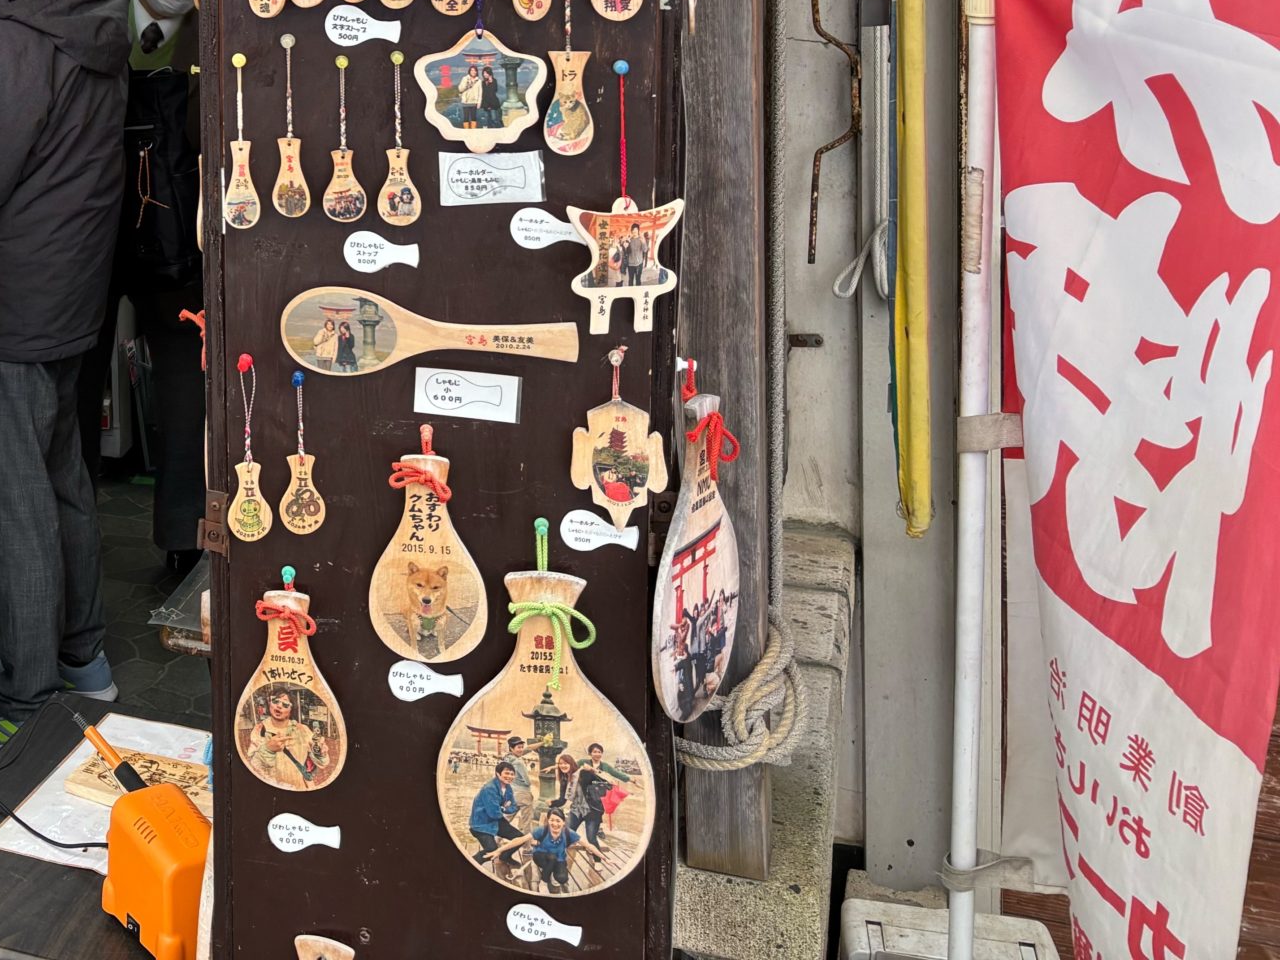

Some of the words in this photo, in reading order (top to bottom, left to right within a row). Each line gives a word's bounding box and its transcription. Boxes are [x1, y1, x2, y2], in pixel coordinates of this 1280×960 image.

[331, 13, 368, 25] びわしゃもじ
[337, 32, 359, 42] 500円
[561, 68, 578, 82] トラ
[455, 168, 493, 176] キーホルダー
[518, 216, 551, 225] キーホルダー
[349, 240, 385, 250] びわしゃもじ
[597, 294, 607, 317] 宮島
[464, 334, 489, 347] 宮島
[435, 377, 462, 387] しゃもじ
[443, 386, 452, 394] 小
[433, 393, 463, 404] 600円
[424, 492, 441, 533] おすわり
[569, 519, 601, 528] キーホルダー
[401, 543, 452, 555] 2015.9.15
[391, 670, 432, 682] びわしゃもじ
[398, 685, 425, 695] 900円
[271, 823, 311, 833] びわしゃもじ
[278, 837, 305, 846] 900円
[512, 909, 553, 927] びわしゃもじ
